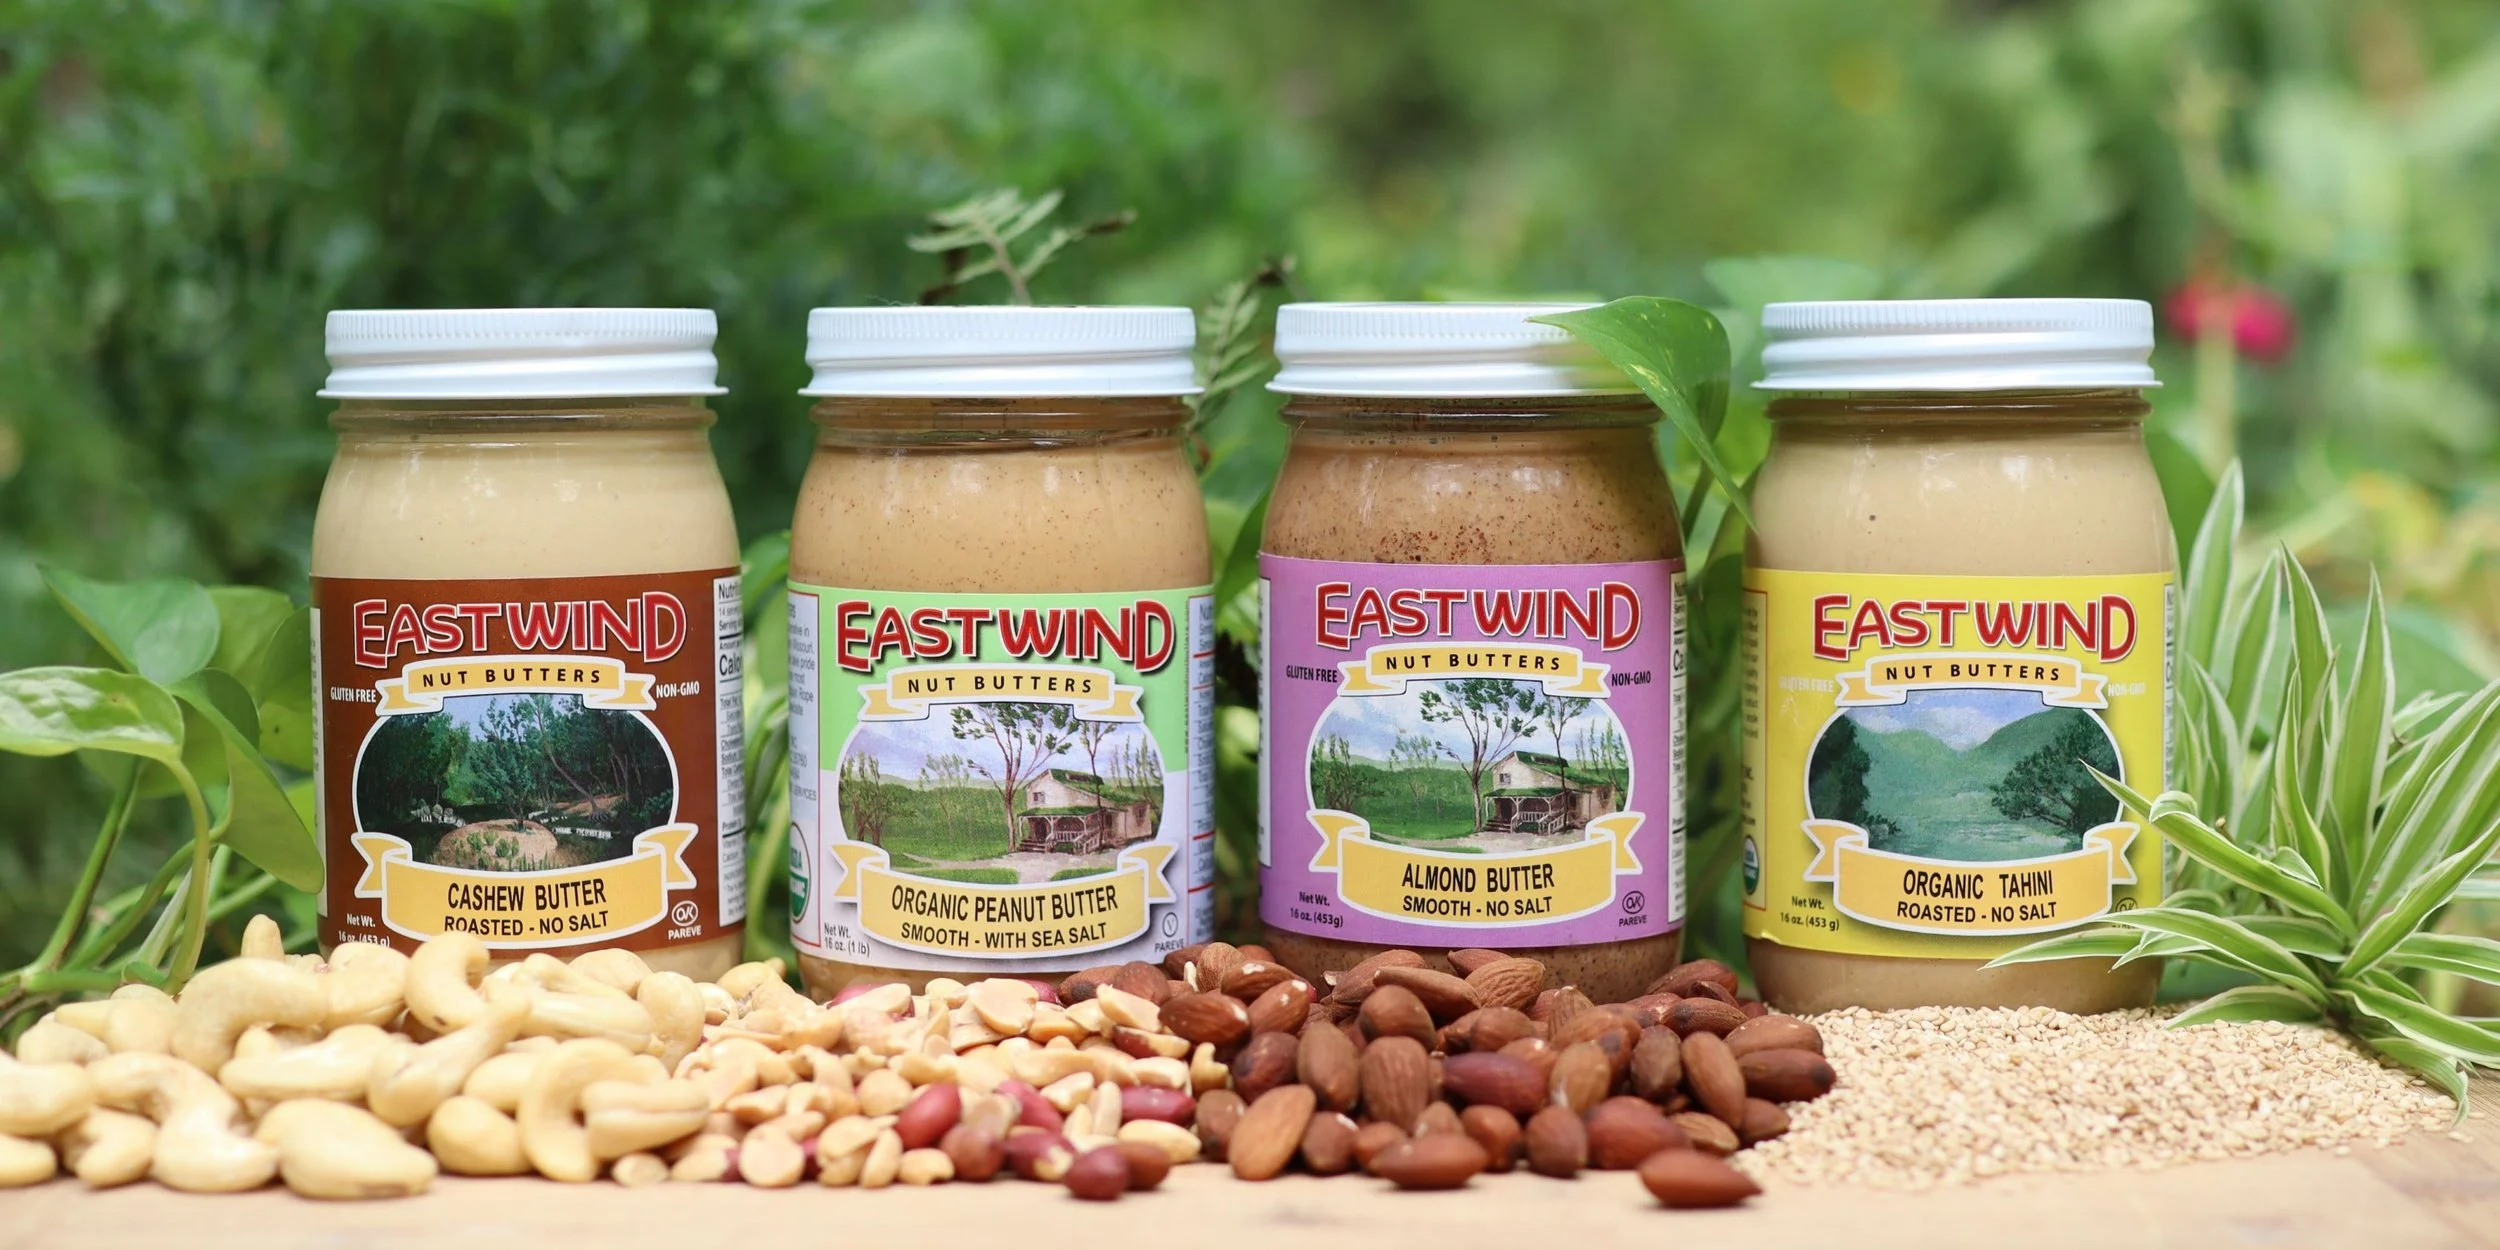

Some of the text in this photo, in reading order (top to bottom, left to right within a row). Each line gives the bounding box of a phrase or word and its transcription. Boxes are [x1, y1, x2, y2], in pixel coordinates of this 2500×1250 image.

[1386, 653, 1559, 670] NUT BUTTERS
[423, 668, 600, 688] NUT BUTTERS
[1286, 665, 1337, 683] GLUTEN FREE
[1612, 671, 1651, 686] NON-GMO
[1886, 664, 2060, 681] NUT BUTTERS
[656, 681, 700, 698] NON-GMO
[908, 675, 1092, 694] NUT BUTTERS
[330, 686, 376, 702] GLUTEN FREE
[1402, 863, 1555, 892] ALMOND BUTTER
[1903, 869, 2053, 899] ORGANIC TAHINI
[448, 878, 607, 911] CASHEW BUTTER
[1299, 891, 1330, 906] Net Wt.
[1791, 896, 1824, 910] Net Wt.
[892, 885, 1119, 923] ORGANIC PEANUT BUTTER
[1403, 895, 1471, 916] SMOOTH
[1486, 900, 1509, 916] NO
[1514, 896, 1552, 915] SALT
[1897, 901, 1976, 923] ROASTED
[1991, 906, 2014, 923] NO
[2019, 902, 2057, 921] SALT
[347, 912, 376, 928] Net Wt.
[1290, 907, 1299, 919] 16
[1300, 912, 1312, 921] oz.
[1618, 915, 1647, 927] PAREVE
[1780, 911, 1789, 923] 16
[1791, 916, 1804, 925] oz.
[444, 915, 523, 936] ROASTED
[539, 917, 564, 934] NO
[568, 910, 608, 932] SALT
[824, 922, 836, 936] Net
[338, 930, 346, 942] 16
[668, 925, 702, 940] PAREVE
[901, 922, 969, 947] SMOOTH
[985, 931, 1026, 949] WITH
[1032, 929, 1066, 947] SEA
[1069, 922, 1107, 944] SALT
[825, 937, 833, 949] 16
